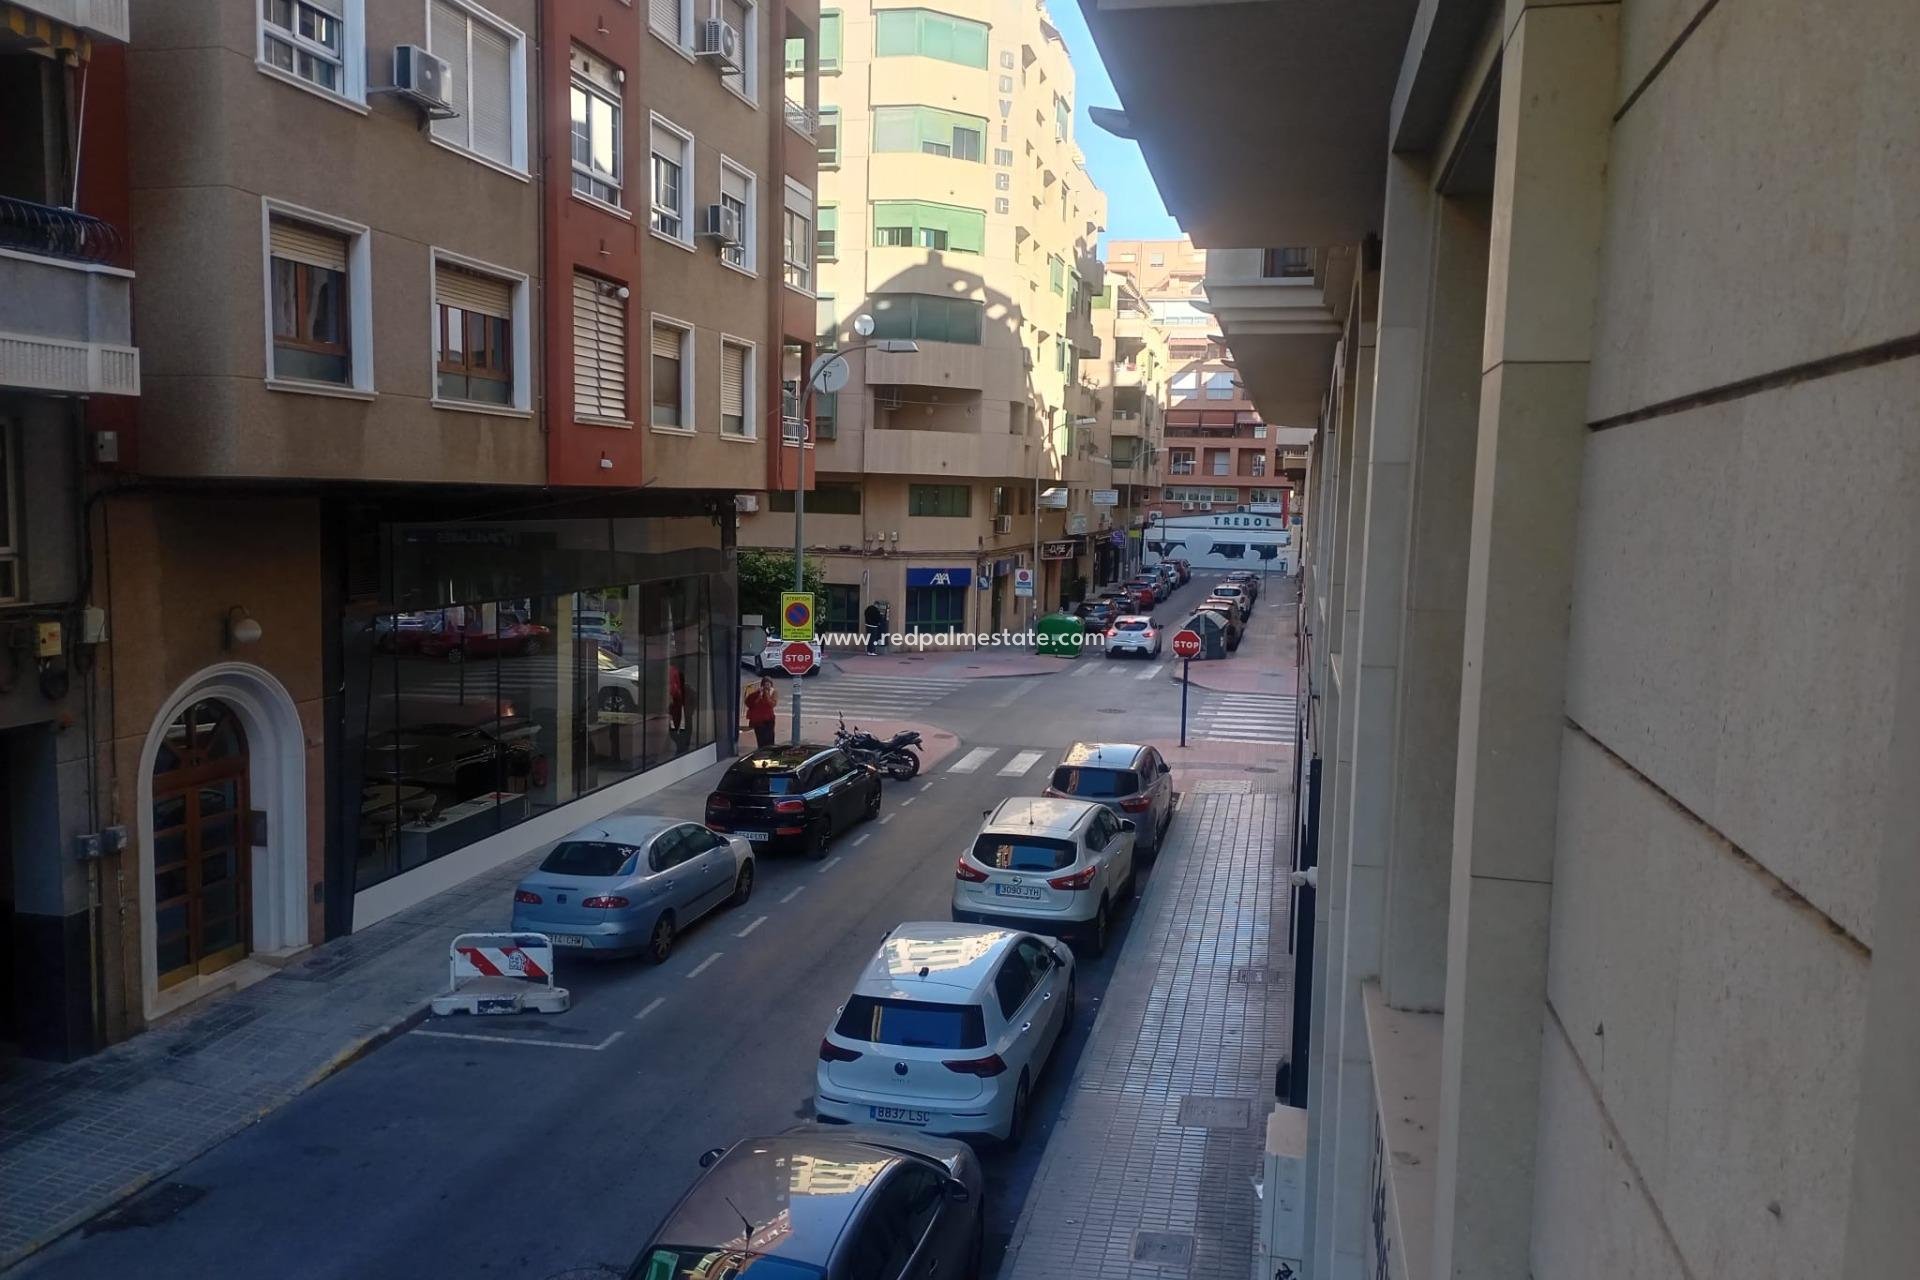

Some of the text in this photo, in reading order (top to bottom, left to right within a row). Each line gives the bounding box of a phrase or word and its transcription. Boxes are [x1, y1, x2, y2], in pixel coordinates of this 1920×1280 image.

[1213, 516, 1272, 527] TREBOL
[930, 572, 951, 585] AXA
[1174, 640, 1199, 649] STOP
[785, 654, 811, 662] STOP
[909, 1110, 930, 1122] LSC
